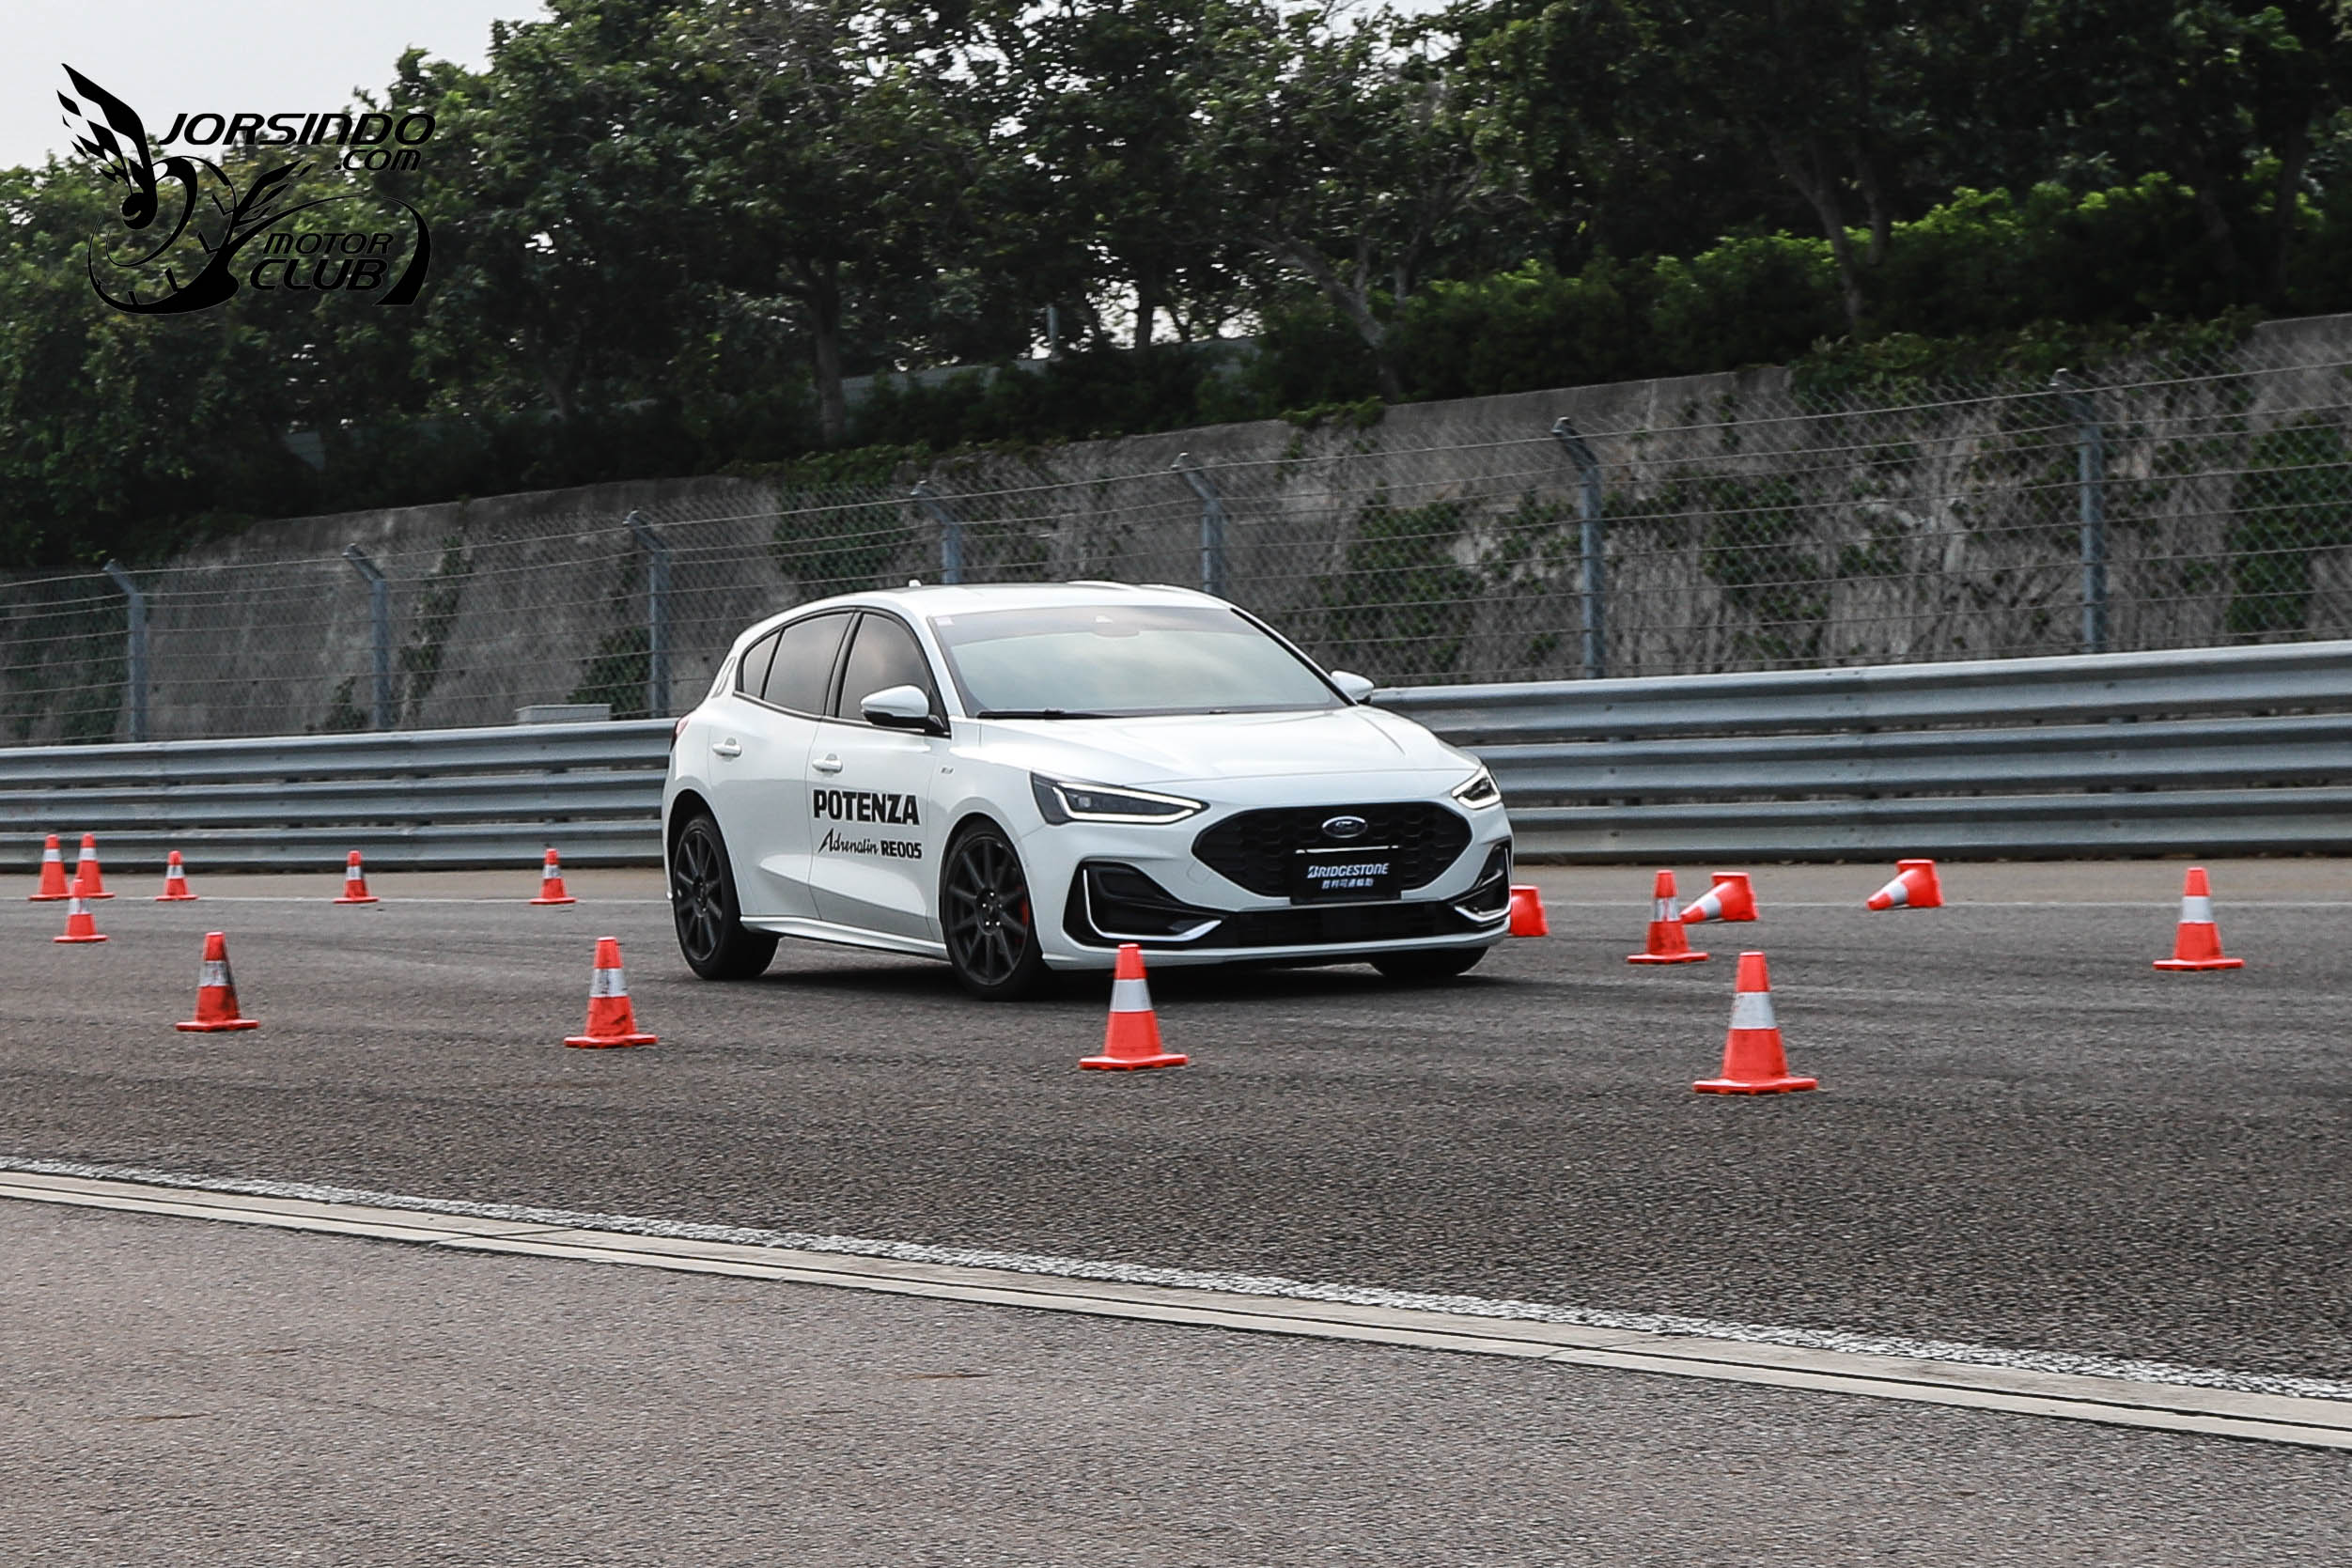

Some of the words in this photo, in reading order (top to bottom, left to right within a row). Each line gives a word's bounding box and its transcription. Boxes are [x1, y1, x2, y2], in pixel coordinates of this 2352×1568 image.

[813, 789, 920, 826] POTENZA
[818, 828, 879, 855] Adrenalin
[880, 840, 922, 859] RE005
[1307, 863, 1389, 878] BRIDGESTONE
